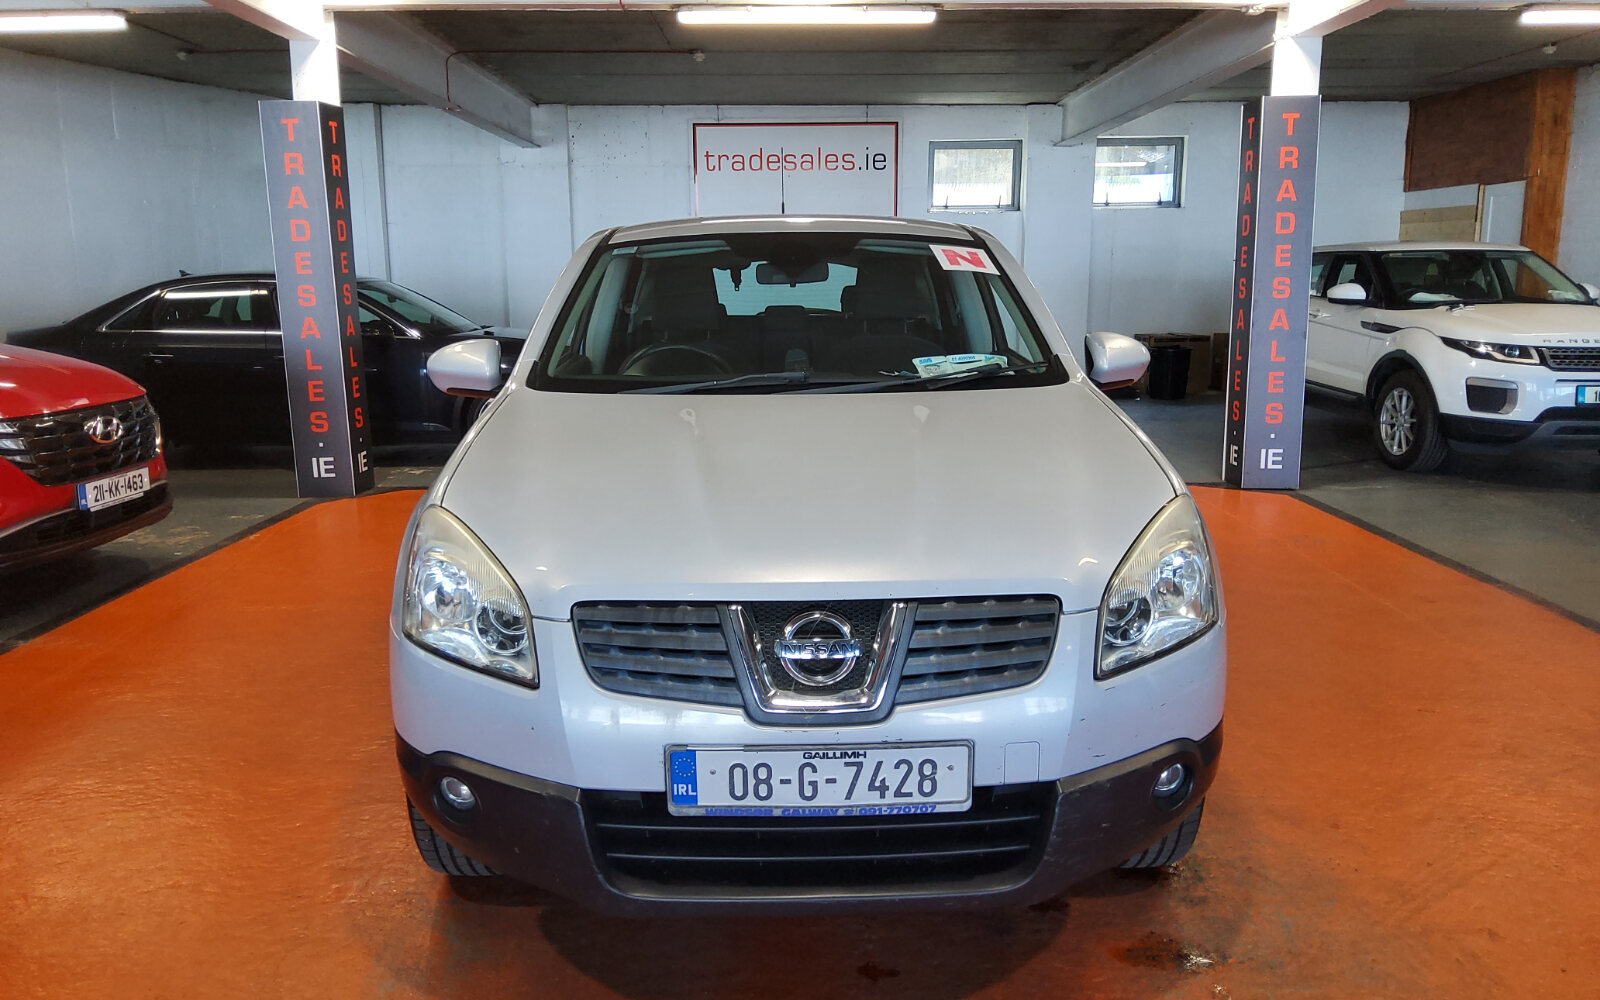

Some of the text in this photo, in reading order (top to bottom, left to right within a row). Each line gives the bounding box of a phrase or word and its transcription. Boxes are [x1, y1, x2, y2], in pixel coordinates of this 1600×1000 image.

[704, 147, 887, 172] tradesales.ie
[941, 249, 987, 269] N
[93, 473, 144, 503] 211-KK-1463
[784, 643, 853, 656] NISSAN
[802, 751, 867, 760] GAILLIMH
[673, 783, 697, 796] IRL
[728, 758, 938, 802] 08-G-7428
